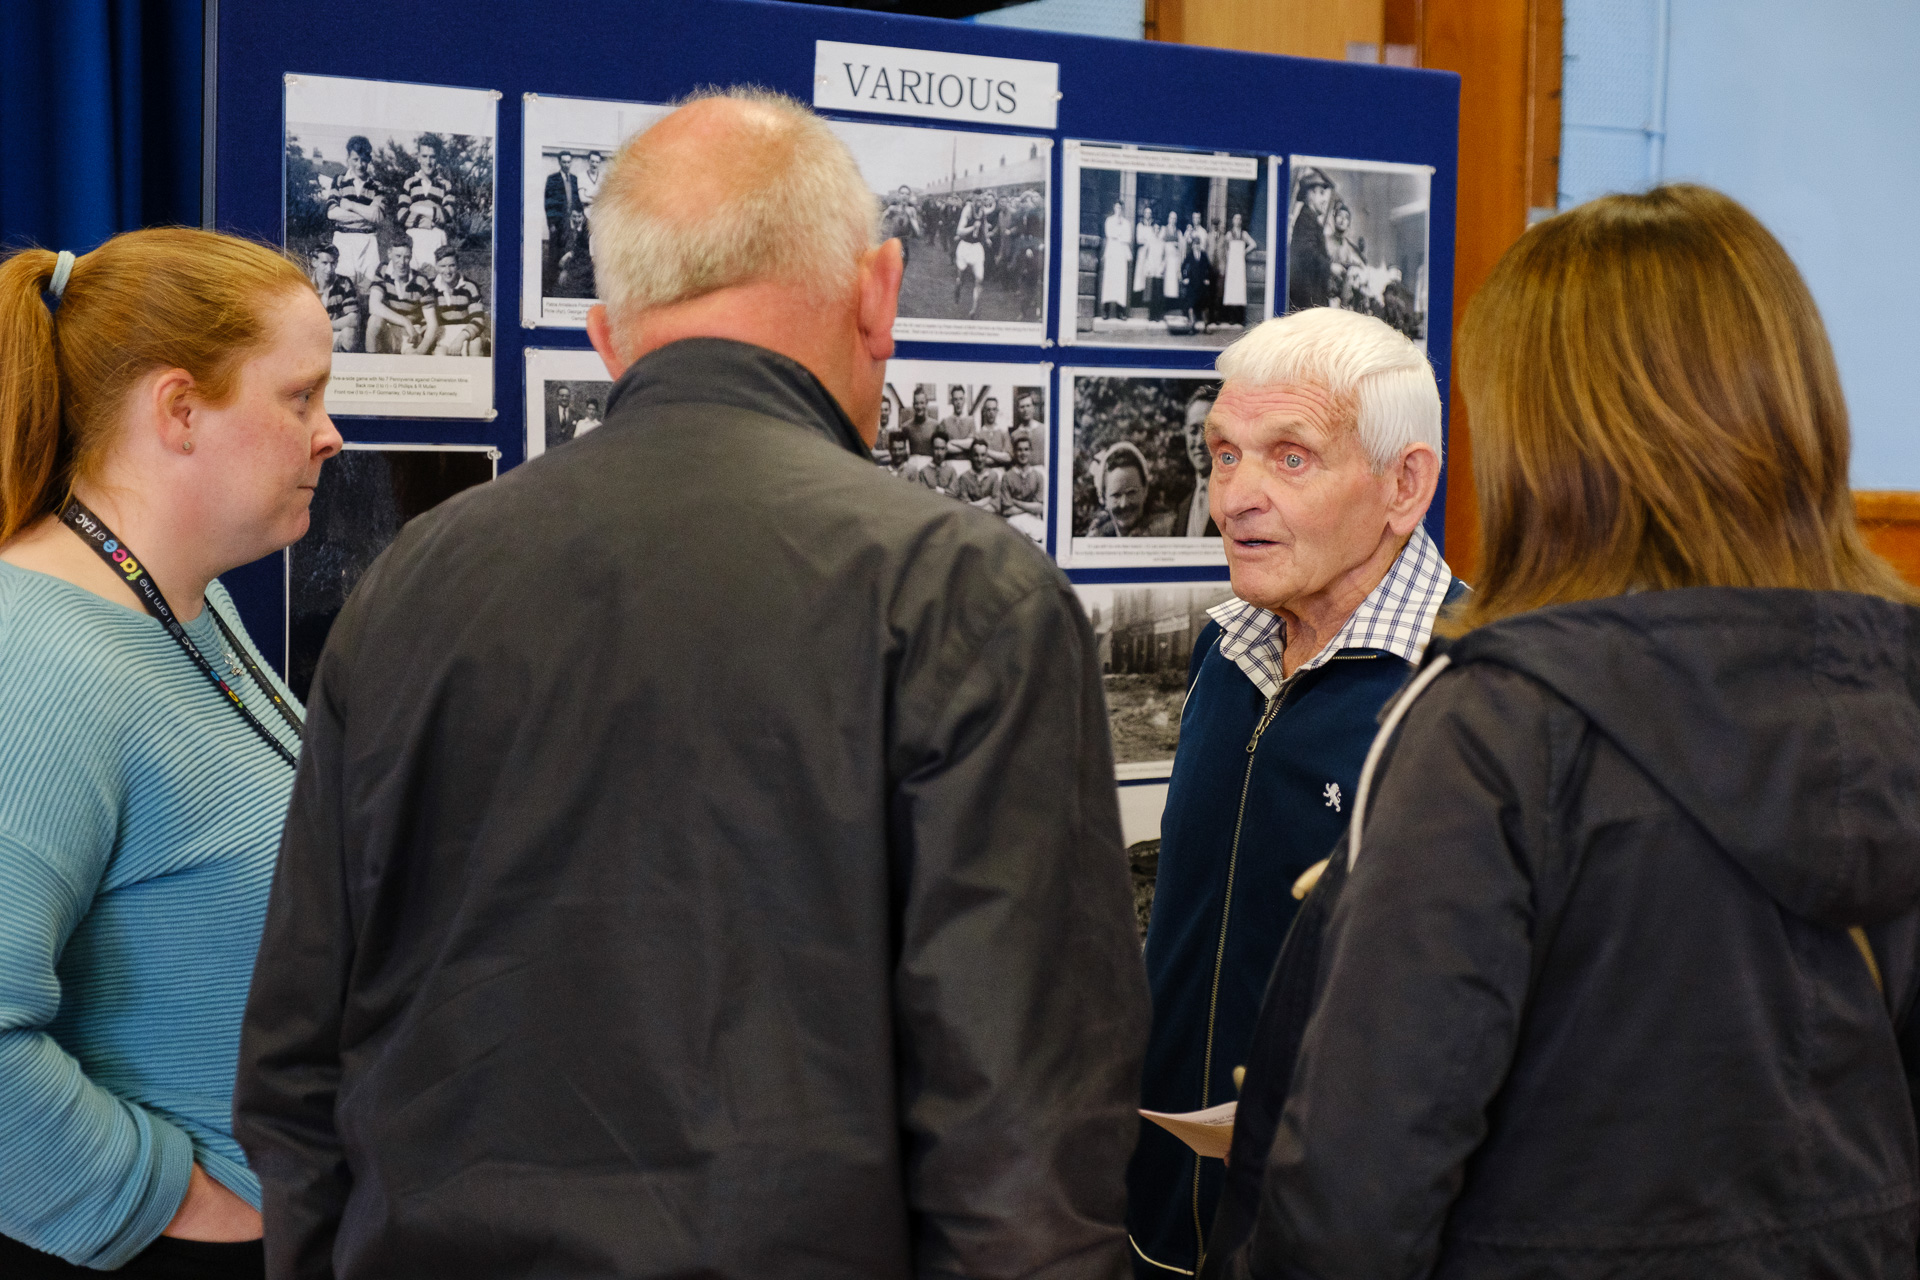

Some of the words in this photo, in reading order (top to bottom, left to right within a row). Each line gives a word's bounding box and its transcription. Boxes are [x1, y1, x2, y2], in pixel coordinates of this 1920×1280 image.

[843, 62, 1017, 114] VARIOUS
[74, 513, 97, 534] EAC
[91, 529, 107, 541] of
[102, 539, 143, 581] face
[139, 578, 156, 598] the
[153, 597, 169, 617] am
[181, 636, 200, 659] EAC
